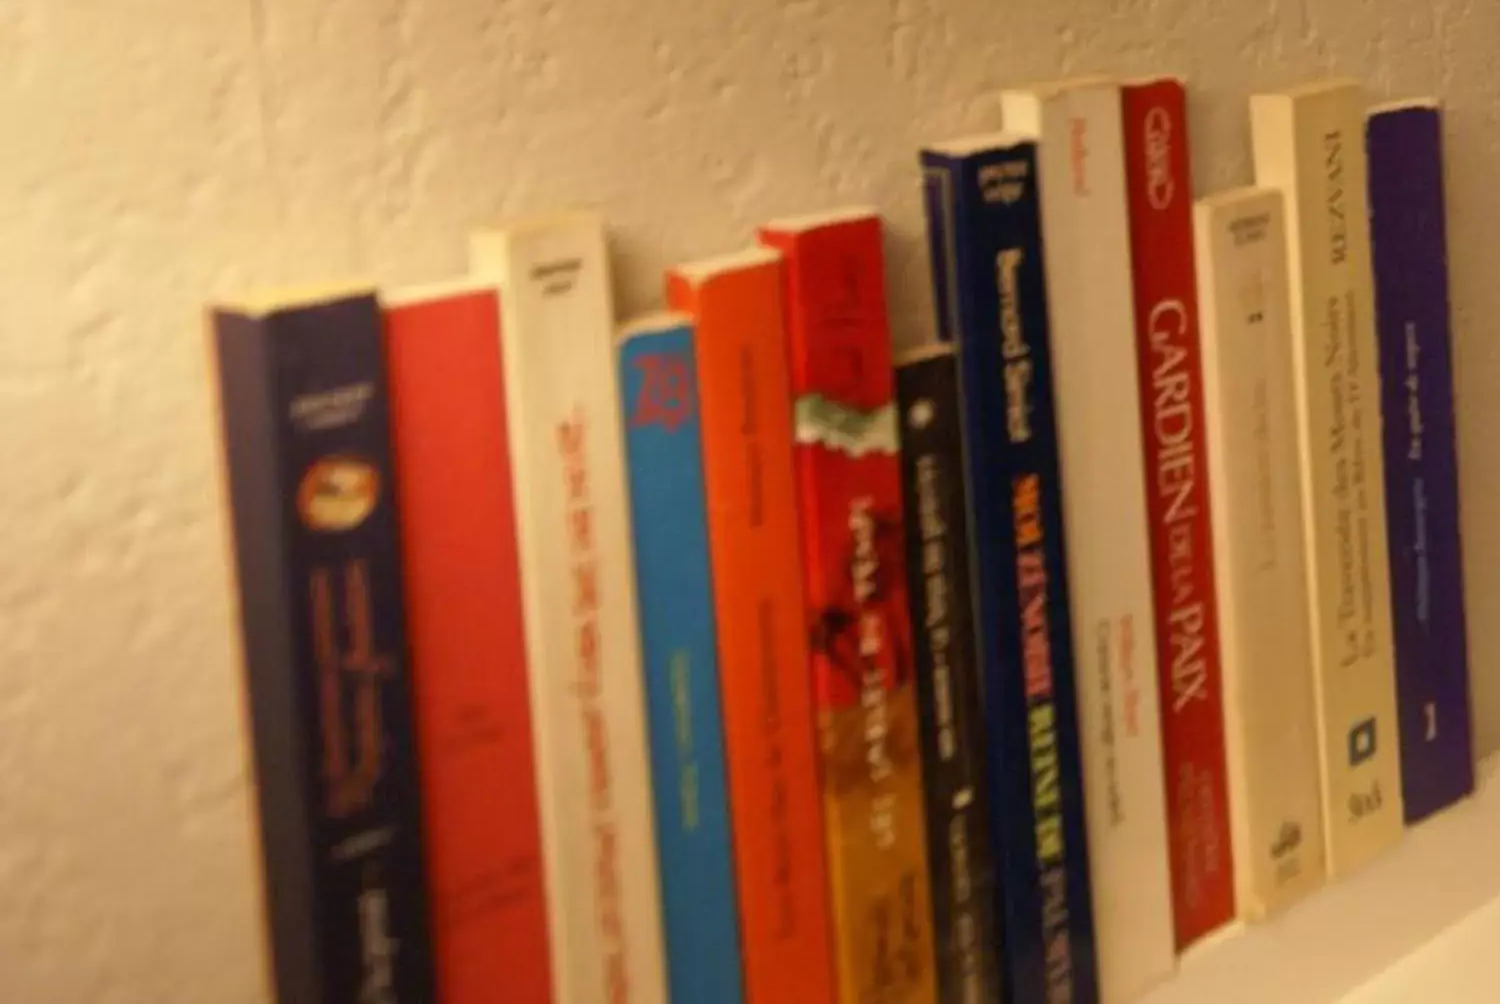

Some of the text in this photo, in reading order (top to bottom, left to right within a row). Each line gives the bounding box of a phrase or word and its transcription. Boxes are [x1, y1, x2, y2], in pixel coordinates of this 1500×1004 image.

[1325, 130, 1348, 266] REZVANI
[996, 247, 1030, 358] Bernard
[1147, 298, 1199, 523] GARDIEN
[1166, 603, 1208, 712] PAIX
[1027, 704, 1060, 808] REINE
[1034, 812, 1063, 859] DE
